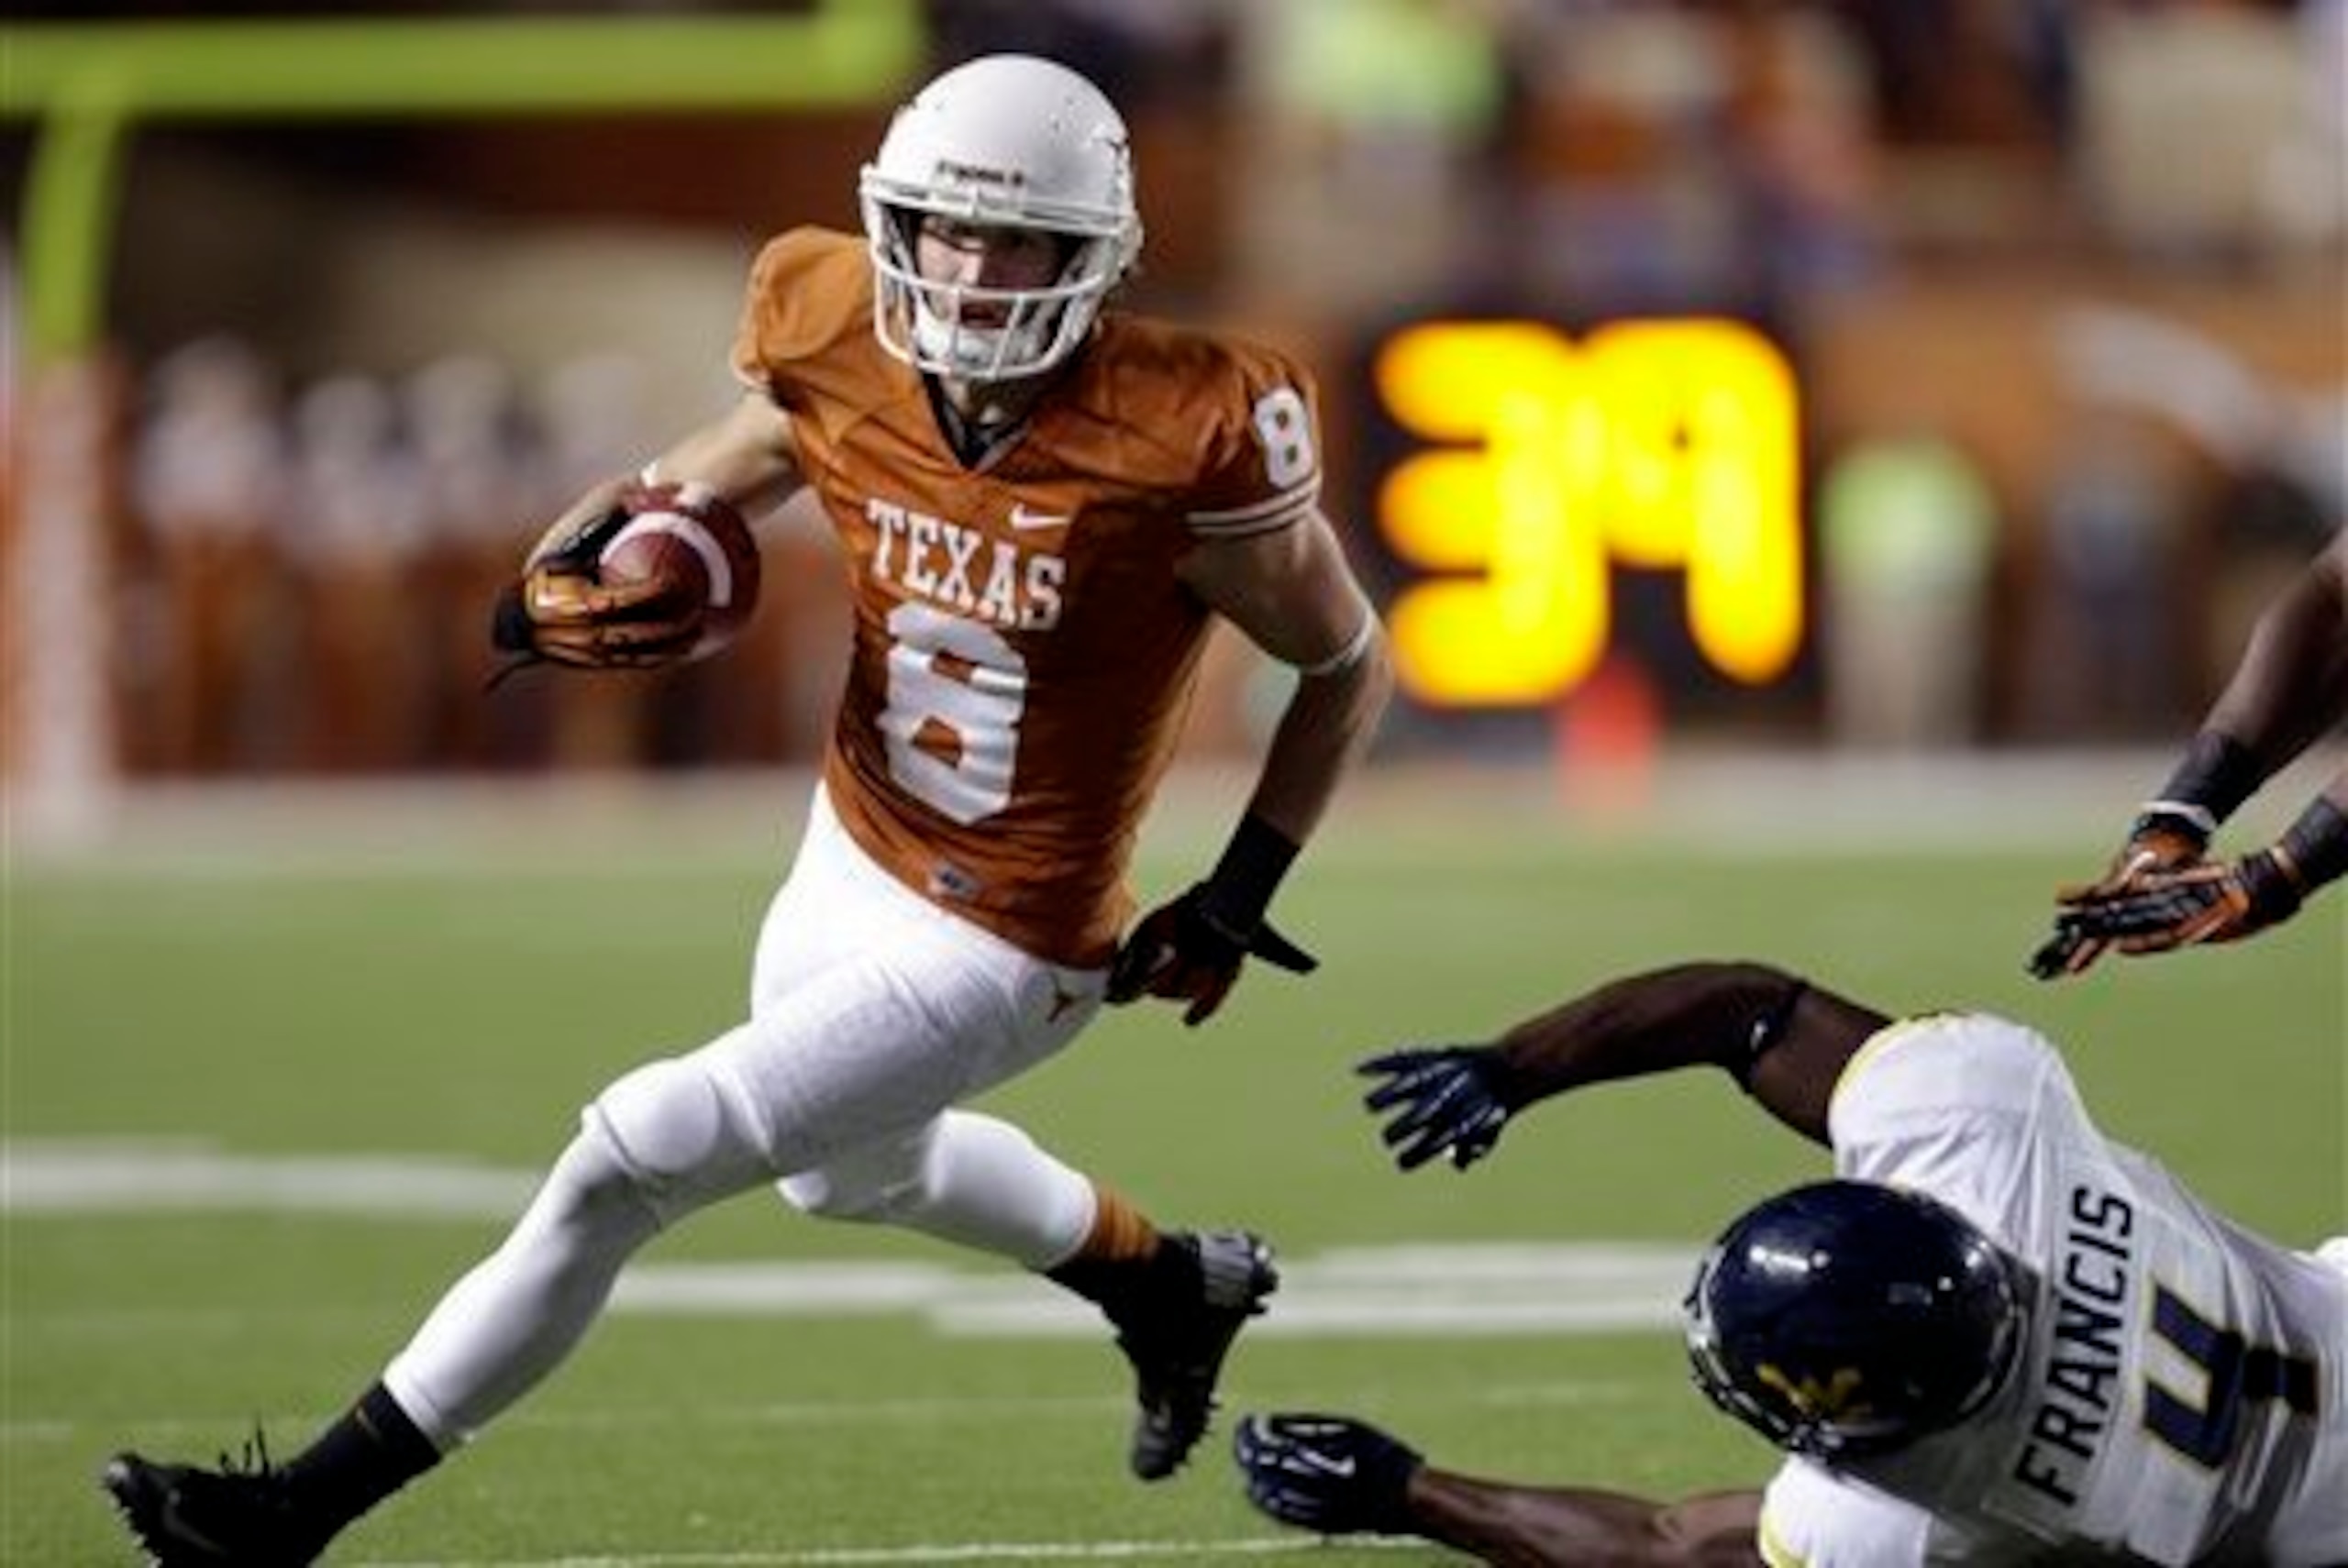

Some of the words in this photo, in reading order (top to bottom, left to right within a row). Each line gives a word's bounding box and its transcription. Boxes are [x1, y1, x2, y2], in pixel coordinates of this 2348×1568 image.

[1254, 386, 1313, 490] 8
[1376, 316, 1802, 708] 39
[866, 498, 1066, 630] TEXAS
[878, 602, 1027, 825] 8
[2013, 1186, 2134, 1507] FRANCIS
